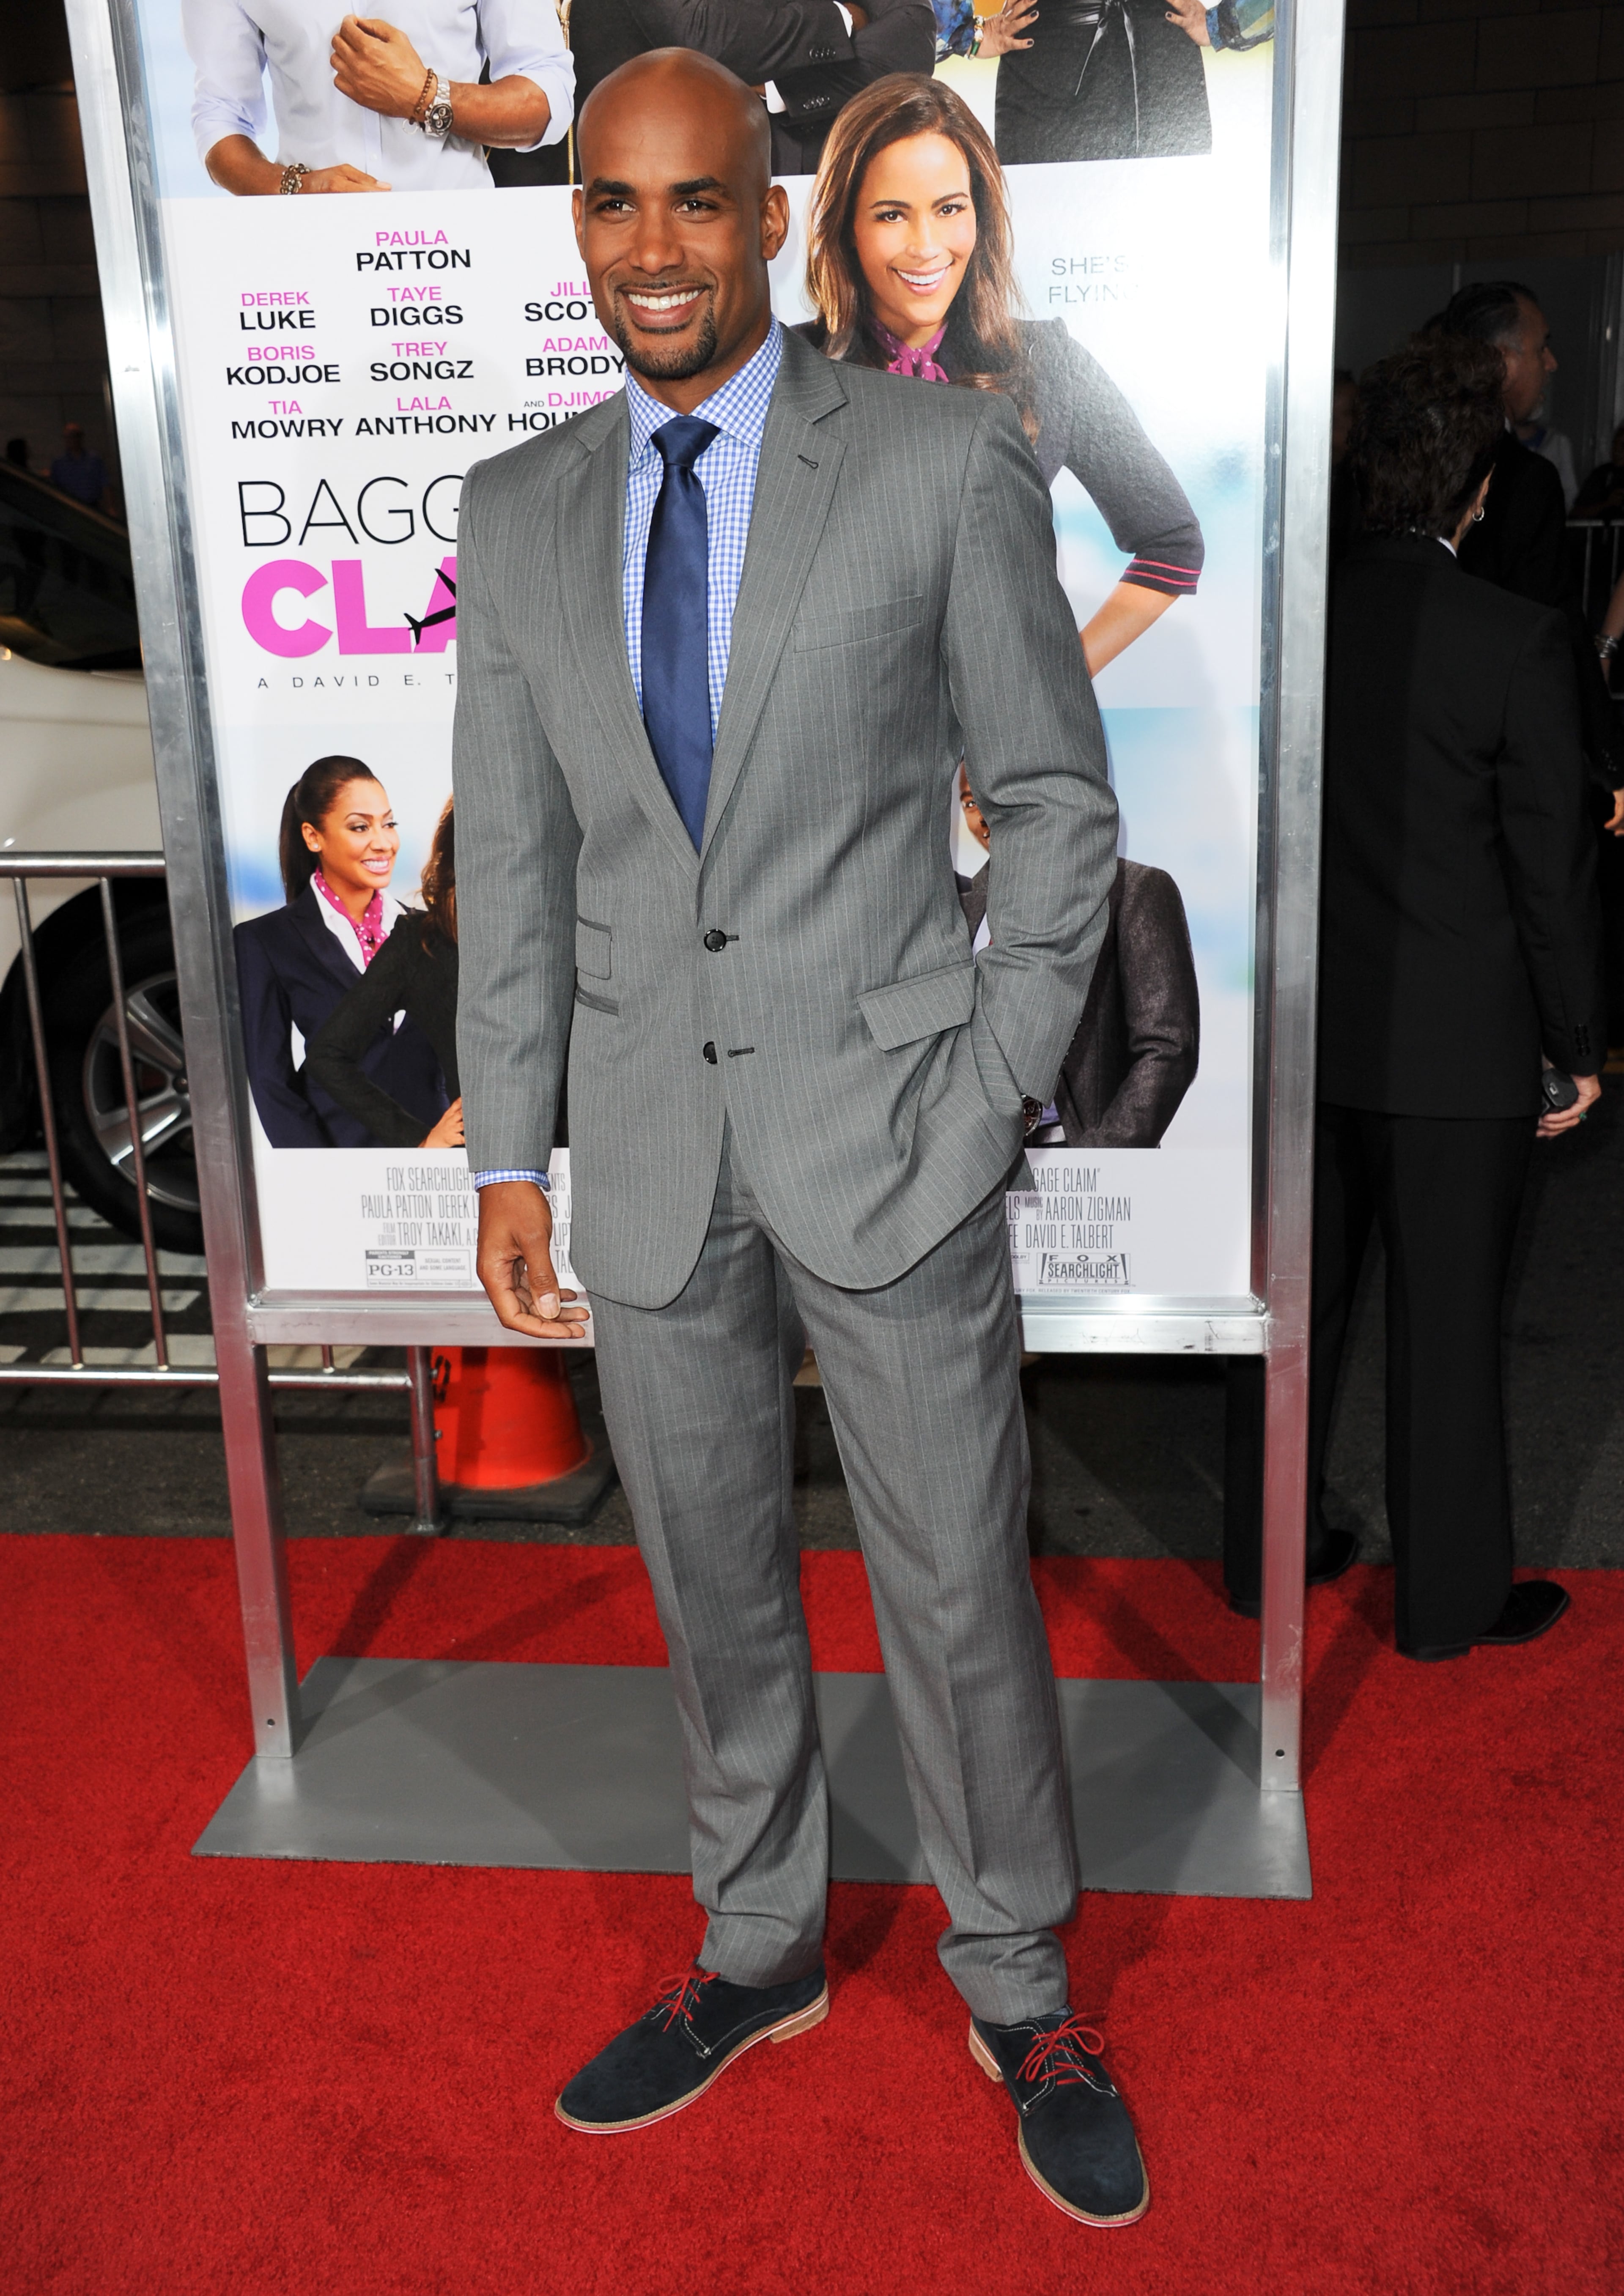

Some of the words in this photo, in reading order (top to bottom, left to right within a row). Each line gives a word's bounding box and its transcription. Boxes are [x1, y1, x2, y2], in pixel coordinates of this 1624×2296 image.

[376, 230, 448, 246] PAULA
[357, 249, 470, 271] PATTON
[387, 287, 442, 301] TAYE
[550, 281, 592, 297] JILL
[241, 292, 310, 306] DEREK
[240, 310, 315, 330] LUKE
[371, 305, 463, 326] DIGGS
[248, 345, 315, 361] BORIS
[392, 342, 447, 357] TREY
[543, 337, 608, 352] ADAM
[370, 361, 474, 381] SONGZ
[526, 355, 625, 376] BRODY
[227, 364, 340, 385] KODJOE
[269, 400, 302, 414] TIA
[397, 396, 452, 411] LALA
[232, 419, 343, 438] MOWRY
[356, 414, 496, 436] ANTHONY
[258, 678, 268, 688] A
[293, 676, 379, 688] DAVID
[404, 675, 420, 685] E.
[387, 1167, 405, 1191] FOX
[1033, 1167, 1059, 1192] GAGE
[362, 1195, 393, 1218] PAULA
[395, 1195, 432, 1218] PATTON
[438, 1195, 469, 1218] DEREK
[1025, 1197, 1043, 1208] MUSIC
[1045, 1197, 1082, 1221] AARON
[1087, 1196, 1130, 1221] ZIGMAN
[1036, 1209, 1043, 1221] BY
[398, 1222, 422, 1246] TROY
[426, 1222, 464, 1247] TAKAKI,
[1026, 1224, 1056, 1248] DAVID
[1061, 1224, 1069, 1248] E.
[1071, 1225, 1114, 1249] TALBERT
[369, 1264, 413, 1276] PG-13
[1048, 1263, 1119, 1278] SEARCHLIGHT
